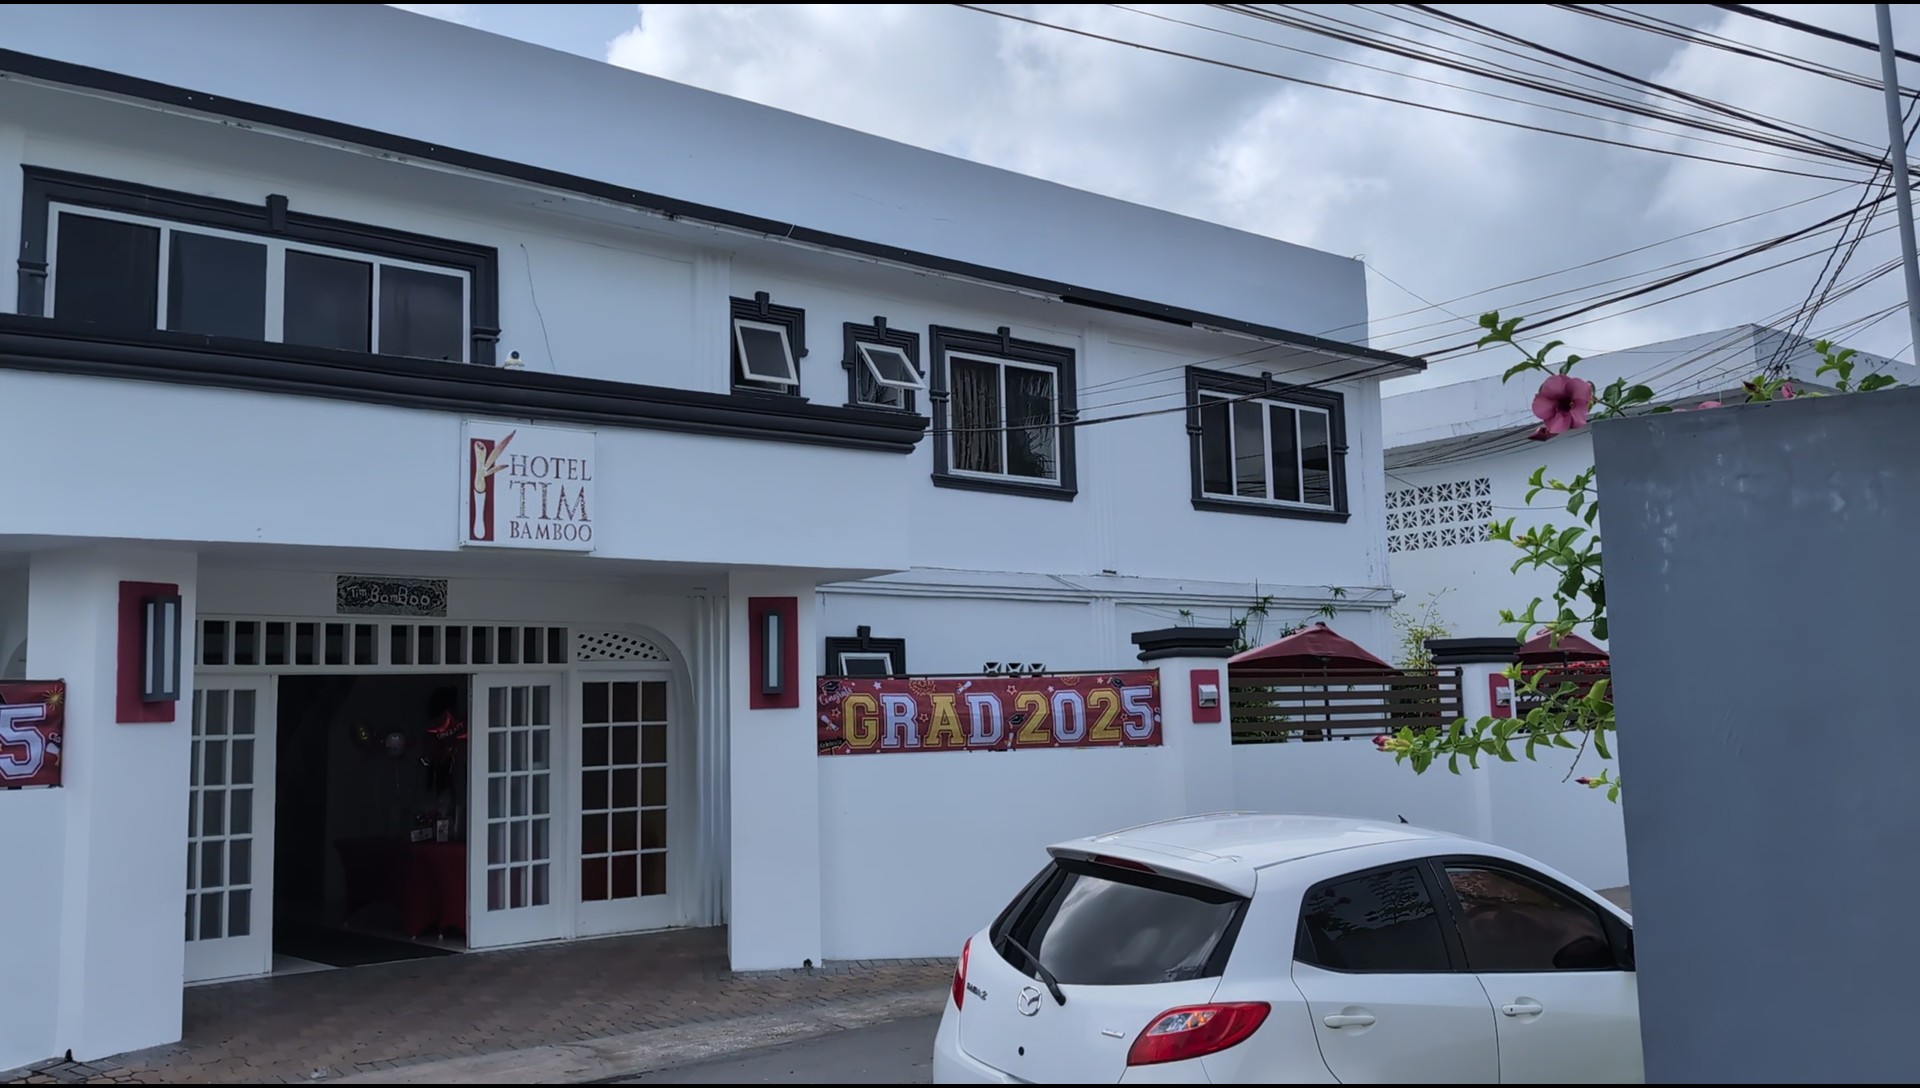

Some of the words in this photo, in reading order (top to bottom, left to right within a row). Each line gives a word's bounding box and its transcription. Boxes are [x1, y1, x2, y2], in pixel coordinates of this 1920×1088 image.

[509, 454, 592, 481] HOTEL
[509, 480, 592, 522] TIM
[509, 521, 592, 542] BAMBOO
[346, 584, 367, 598] Tim
[843, 693, 1003, 747] GRAD
[1014, 686, 1154, 744] 2025
